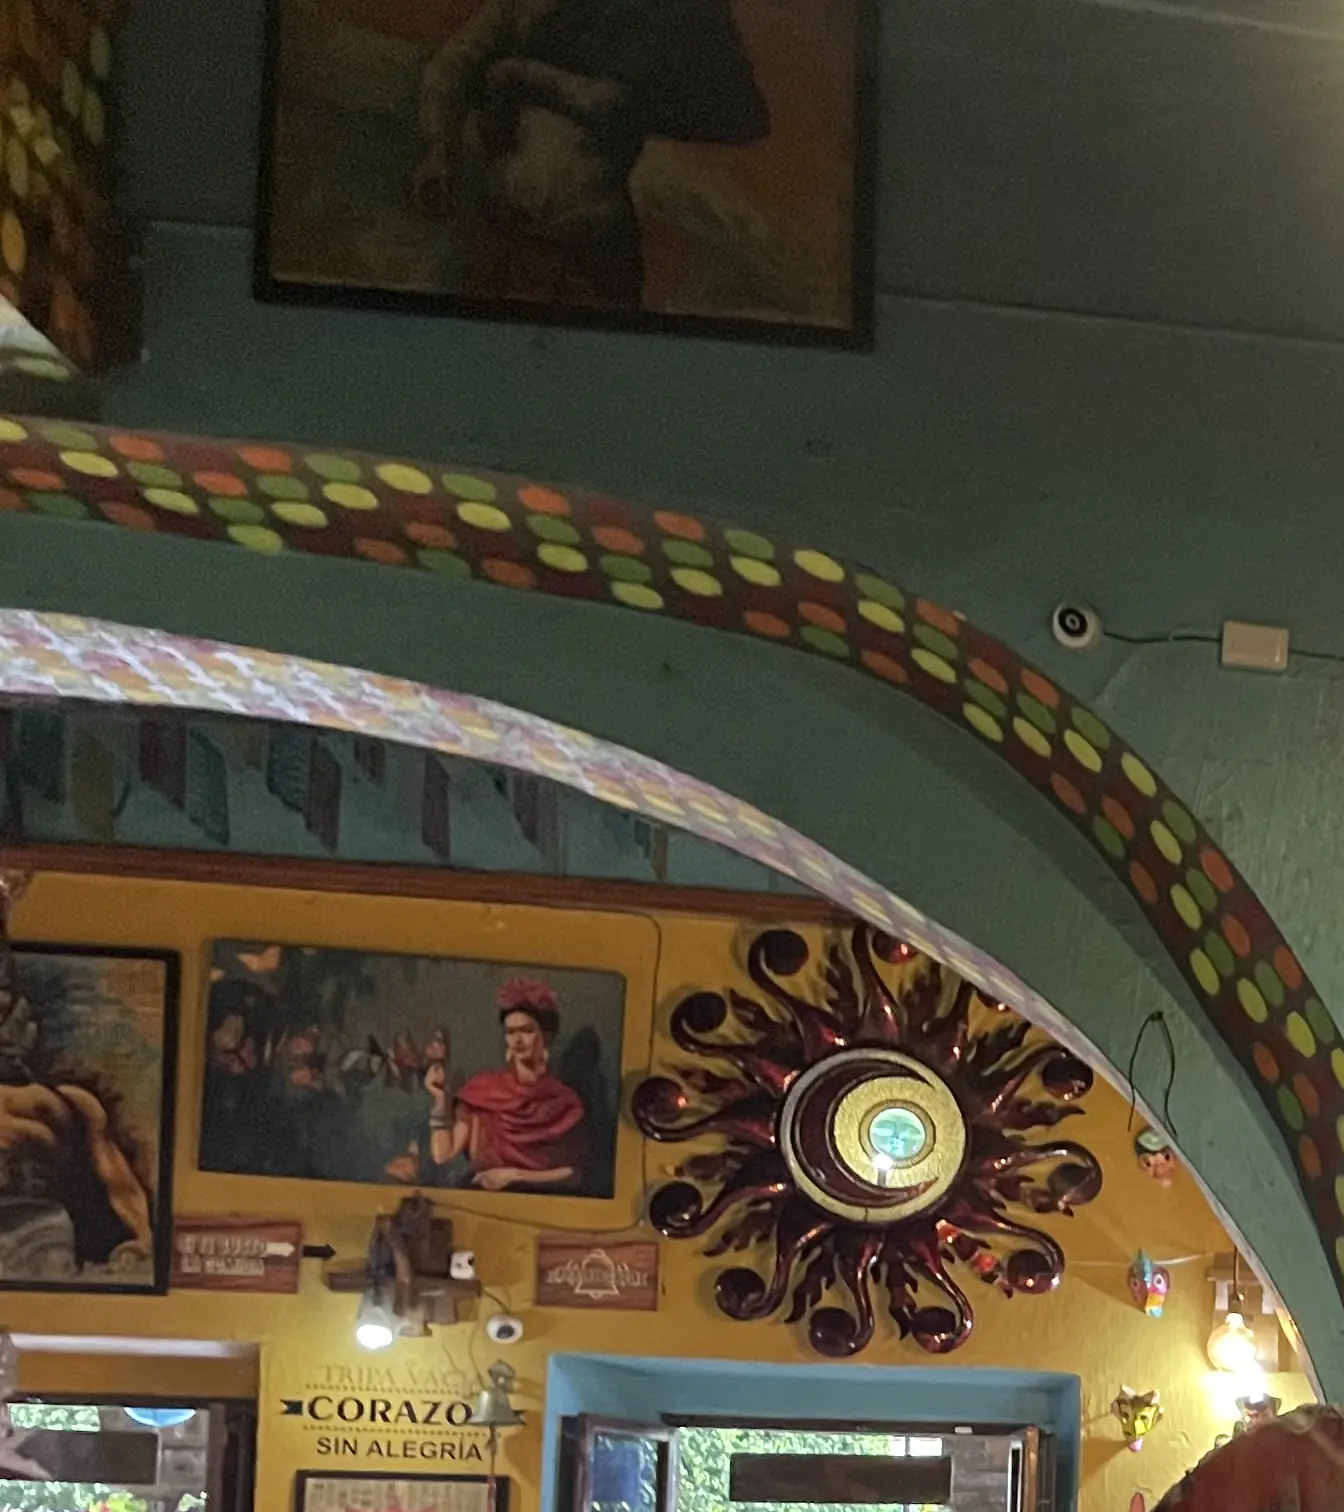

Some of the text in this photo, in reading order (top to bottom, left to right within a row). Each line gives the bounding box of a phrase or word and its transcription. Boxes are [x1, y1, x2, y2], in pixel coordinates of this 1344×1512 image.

[324, 1364, 395, 1387] TRIPA
[308, 1395, 473, 1427] CORAZO
[317, 1436, 358, 1457] SIN
